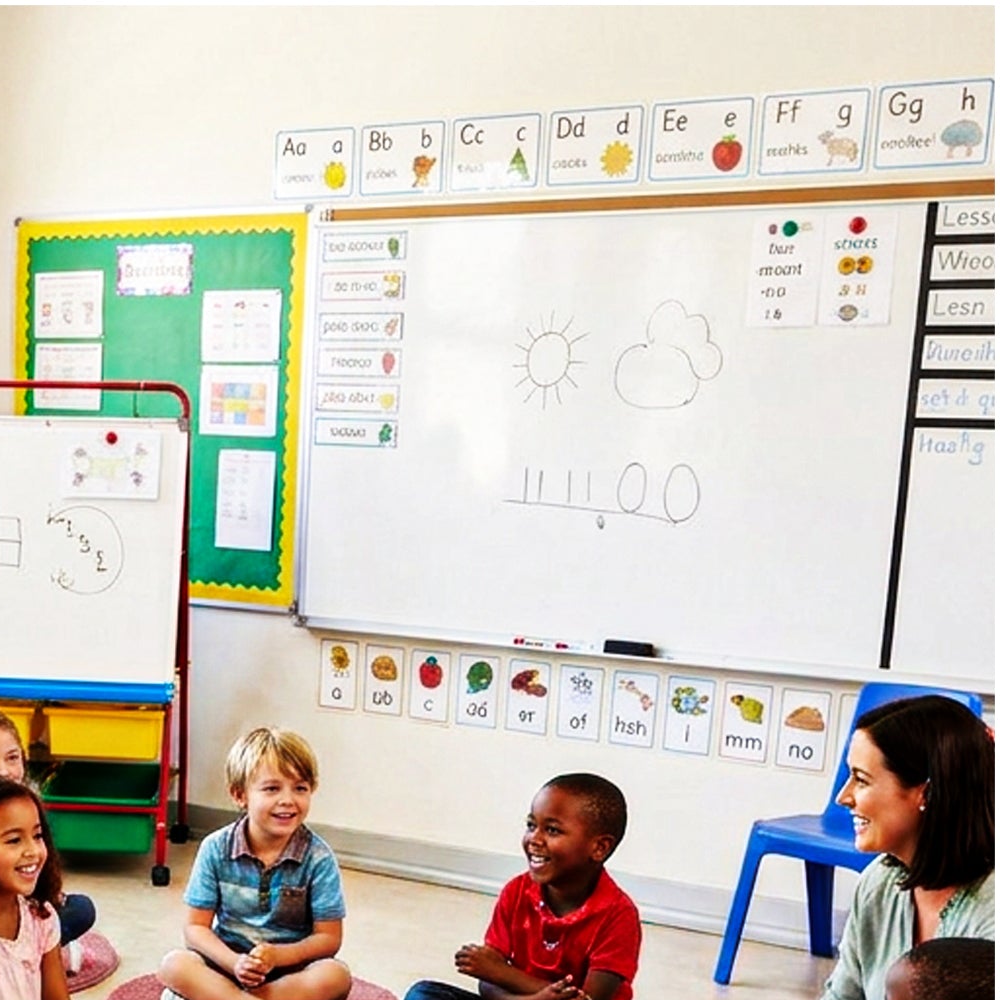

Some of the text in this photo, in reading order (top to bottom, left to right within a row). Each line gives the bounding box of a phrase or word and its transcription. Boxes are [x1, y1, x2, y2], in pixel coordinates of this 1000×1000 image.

[777, 100, 851, 128] Ff g
[889, 87, 975, 123] Gg h
[557, 112, 629, 138] Dd d
[664, 110, 736, 132] Ee e
[369, 128, 431, 151] Bb b
[460, 124, 525, 145] Cc c
[283, 138, 342, 156] Aa a
[615, 717, 647, 736] hsh
[726, 735, 762, 750] mm
[789, 744, 813, 760] no
